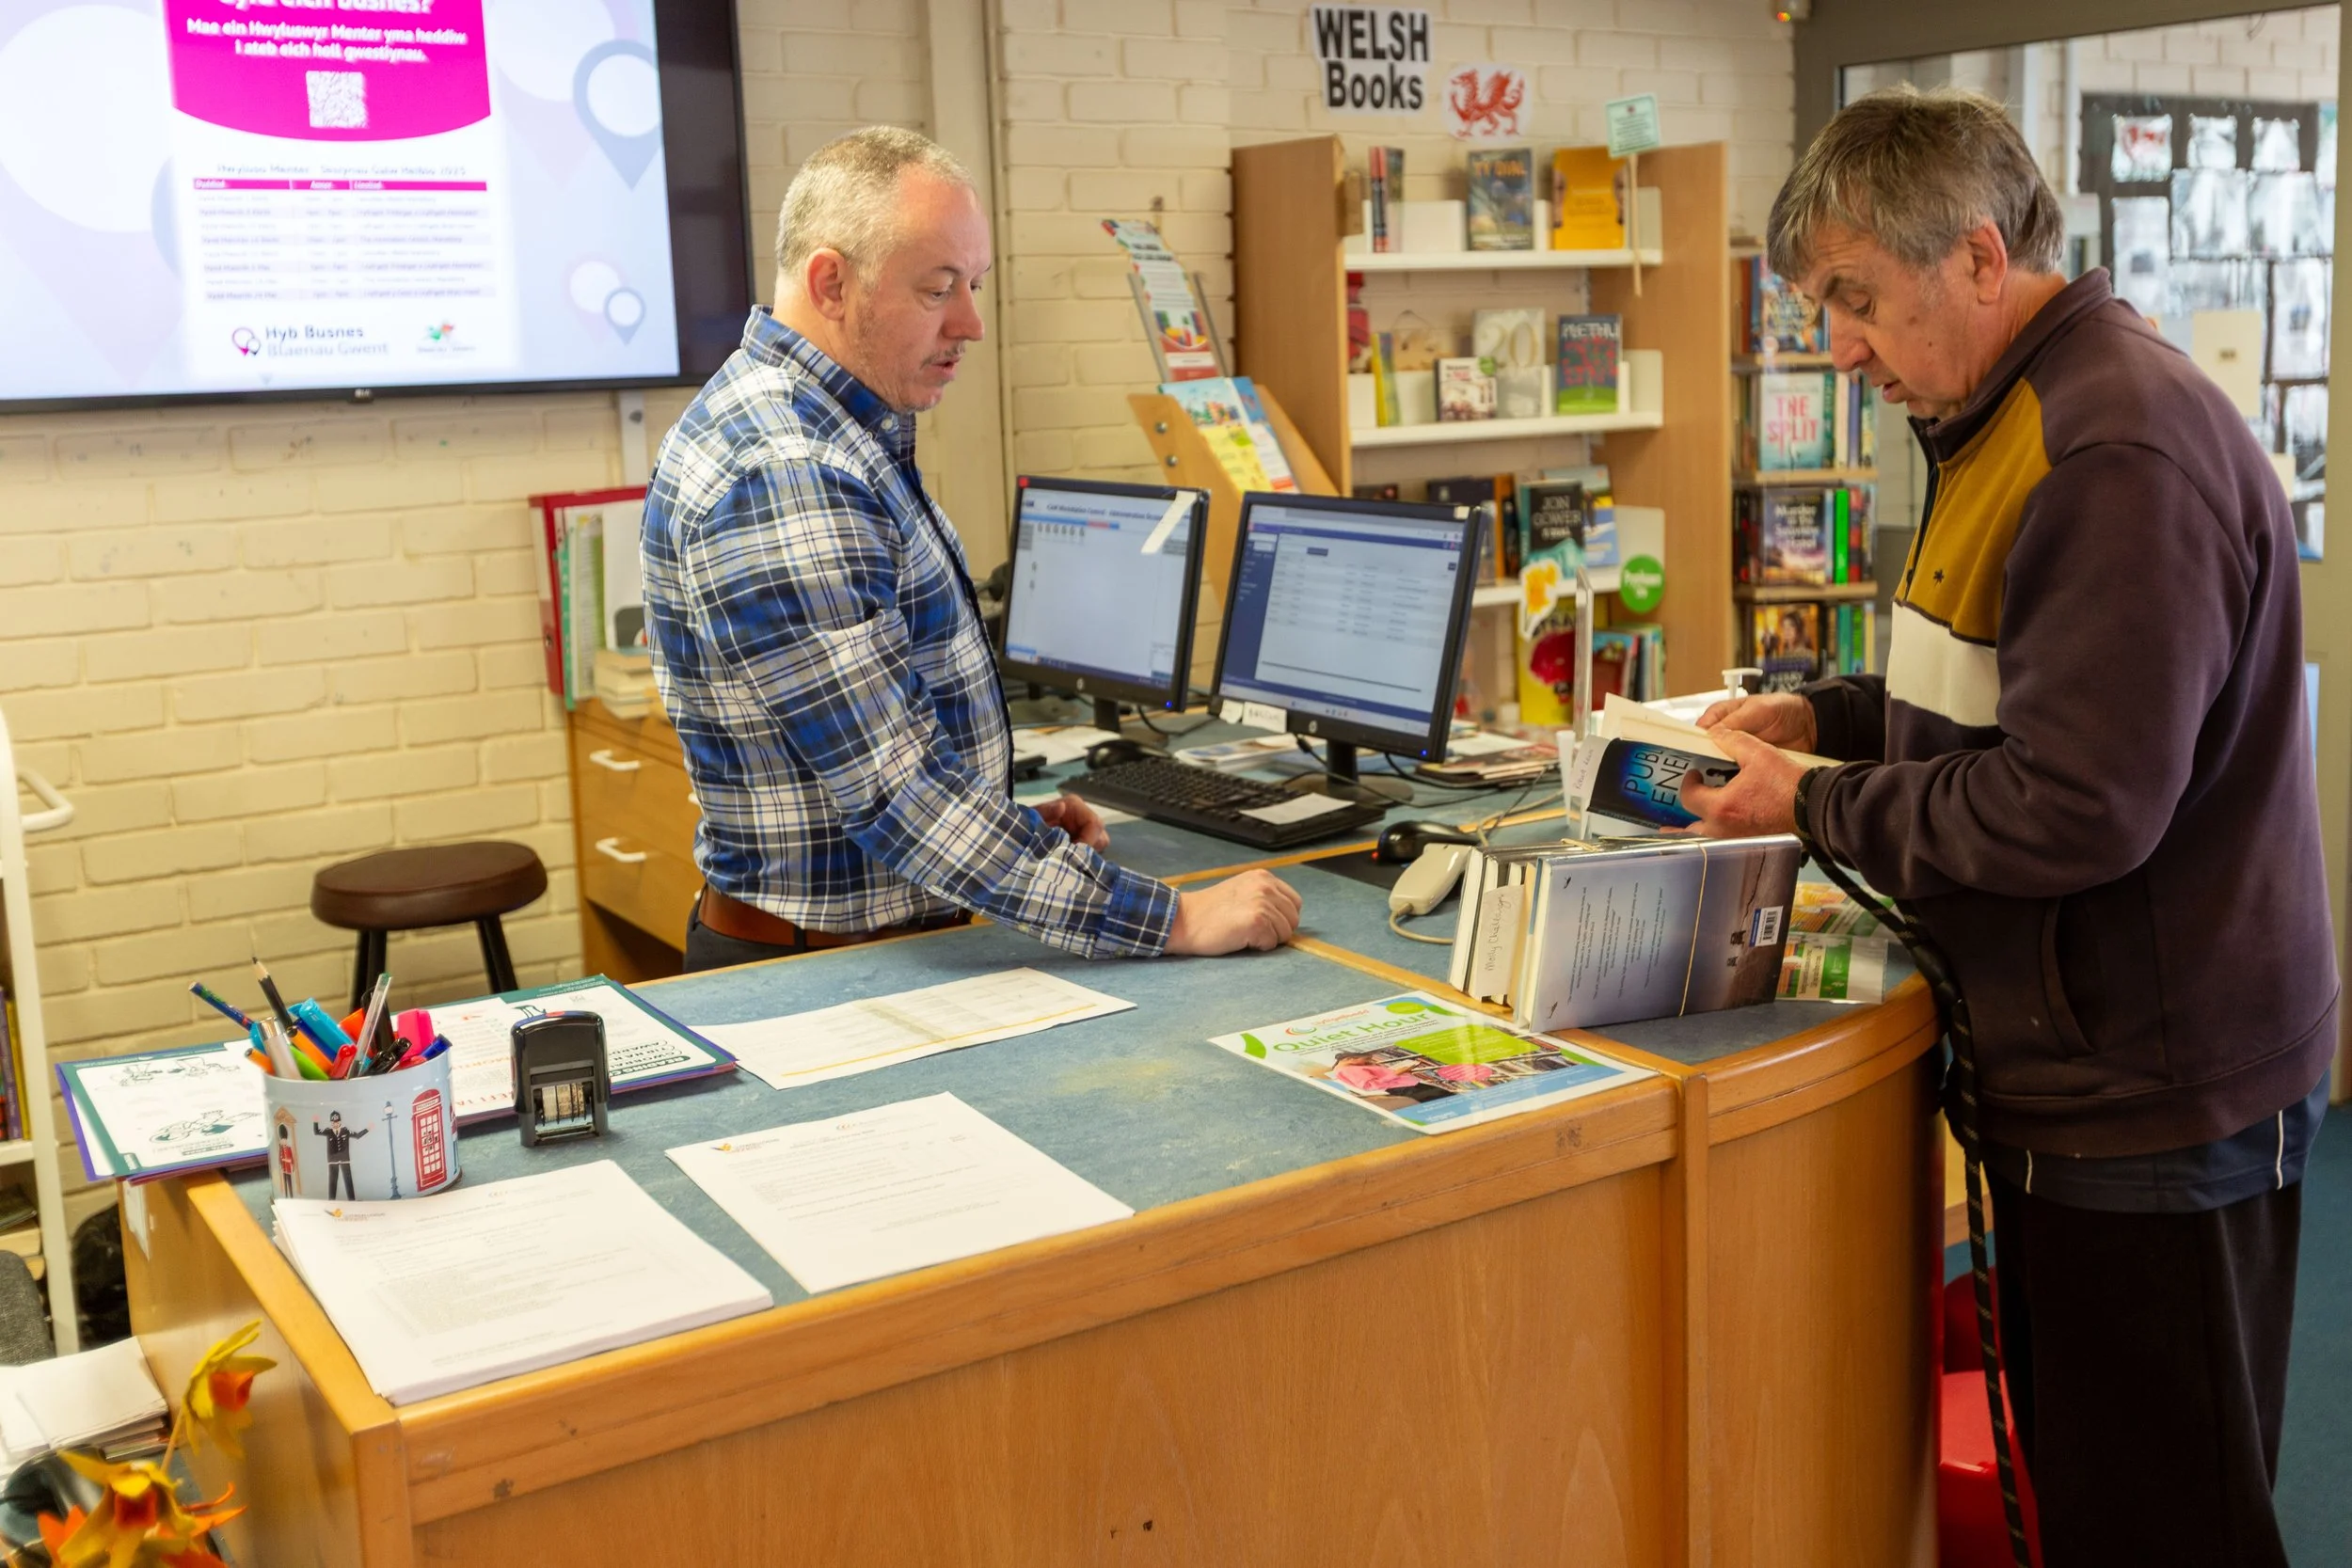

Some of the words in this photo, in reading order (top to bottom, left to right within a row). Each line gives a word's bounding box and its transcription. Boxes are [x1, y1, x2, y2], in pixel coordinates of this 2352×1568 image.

[187, 18, 219, 34] Mae
[222, 20, 247, 35] ein
[331, 24, 383, 41] Menter
[384, 29, 415, 44] yma
[416, 27, 468, 44] heddiw
[1315, 8, 1429, 62] WELSH
[244, 40, 277, 56] ateb
[279, 41, 310, 57] eich
[312, 42, 342, 58] holl
[1327, 60, 1423, 109] Books
[265, 325, 298, 341] Hyb
[305, 325, 364, 338] Busnes
[267, 342, 334, 356] Blaenau
[337, 341, 389, 356] Gwent
[1776, 396, 1808, 417] THE
[1767, 420, 1819, 451] SPLIT
[1543, 496, 1570, 510] JON
[1533, 510, 1581, 527] GOWER
[1274, 1029, 1358, 1052] Quiet
[1357, 1012, 1432, 1033] Hour
[621, 1056, 685, 1073] READING
